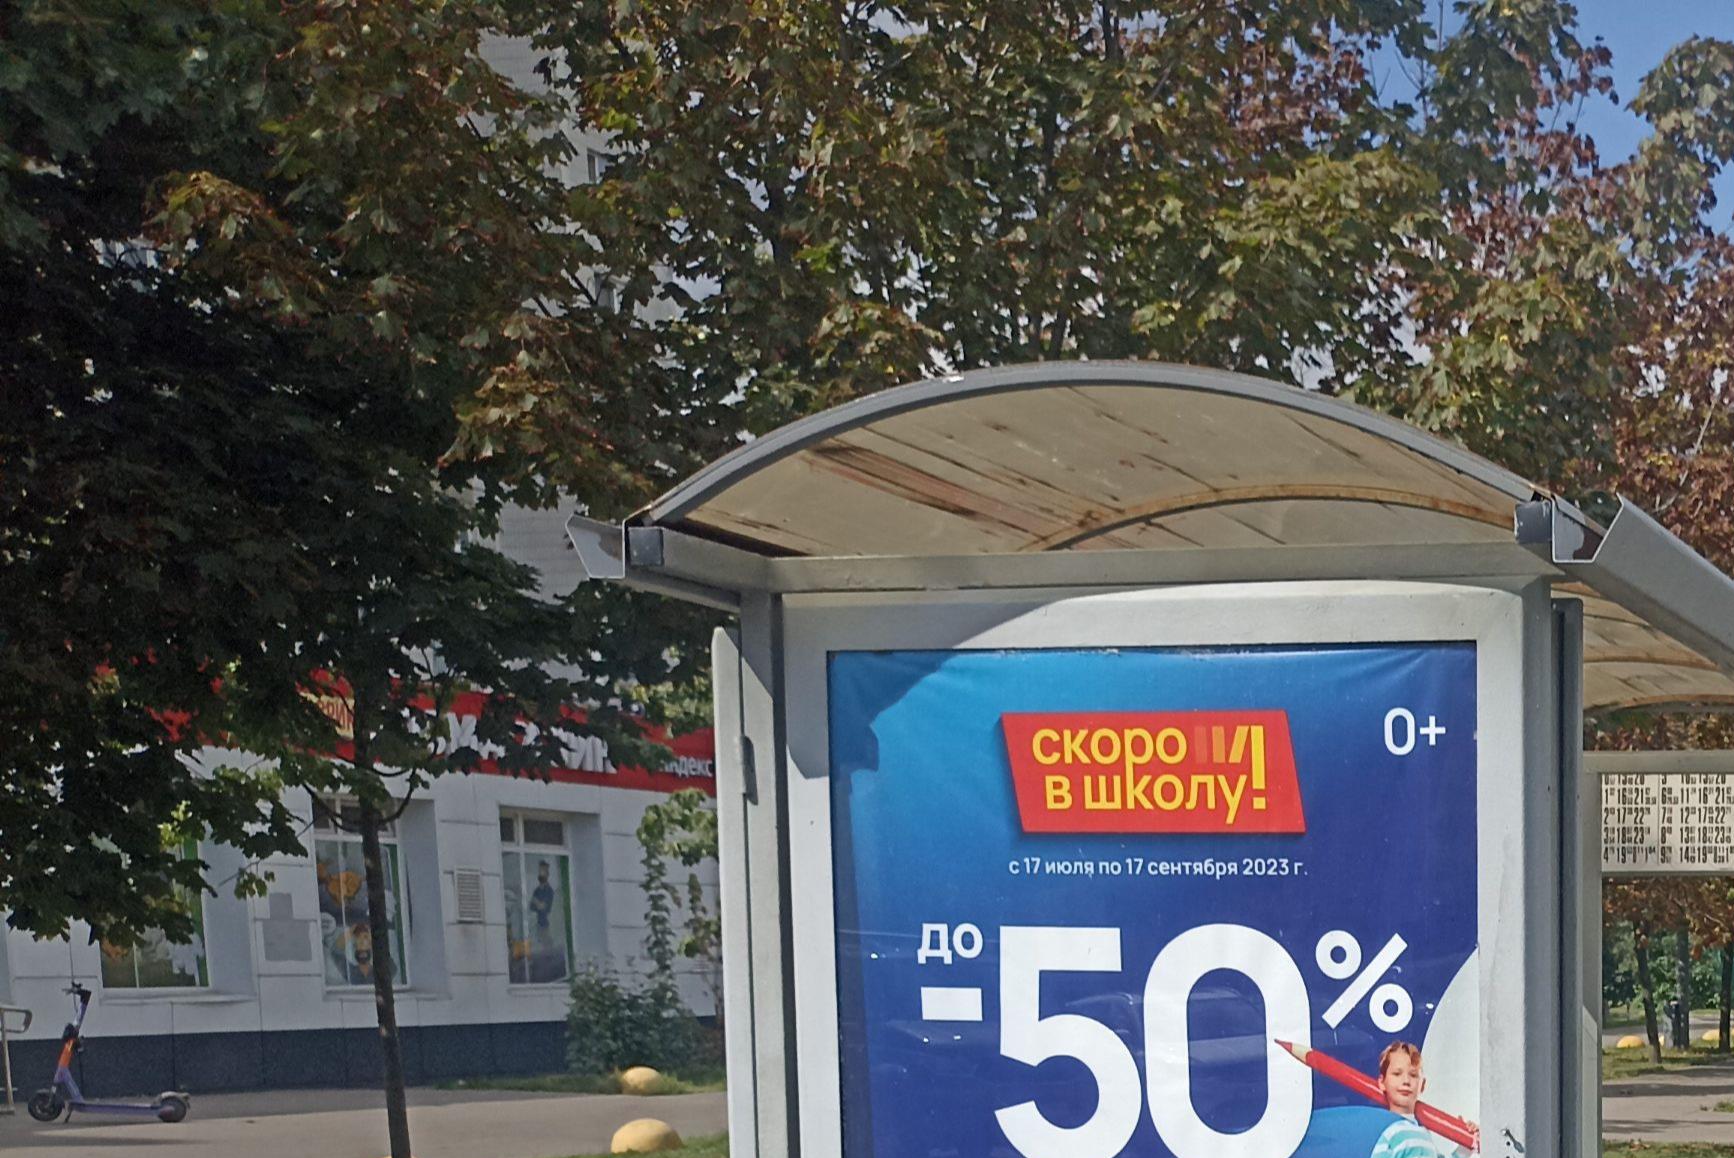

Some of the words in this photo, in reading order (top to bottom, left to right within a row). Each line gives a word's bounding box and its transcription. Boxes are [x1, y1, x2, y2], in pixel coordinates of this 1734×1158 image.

[1383, 709, 1446, 754] 0+
[1032, 725, 1188, 785] скоро
[1045, 772, 1073, 810] в
[1085, 725, 1267, 825] школу!
[1009, 860, 1020, 874] с
[1023, 857, 1041, 873] 17
[1045, 858, 1094, 876] июля
[1099, 858, 1122, 874] по
[1125, 858, 1144, 874] 17
[1148, 858, 1238, 880] сентября
[1242, 858, 1289, 875] 2023
[1294, 860, 1308, 875] г.
[917, 923, 983, 965] до
